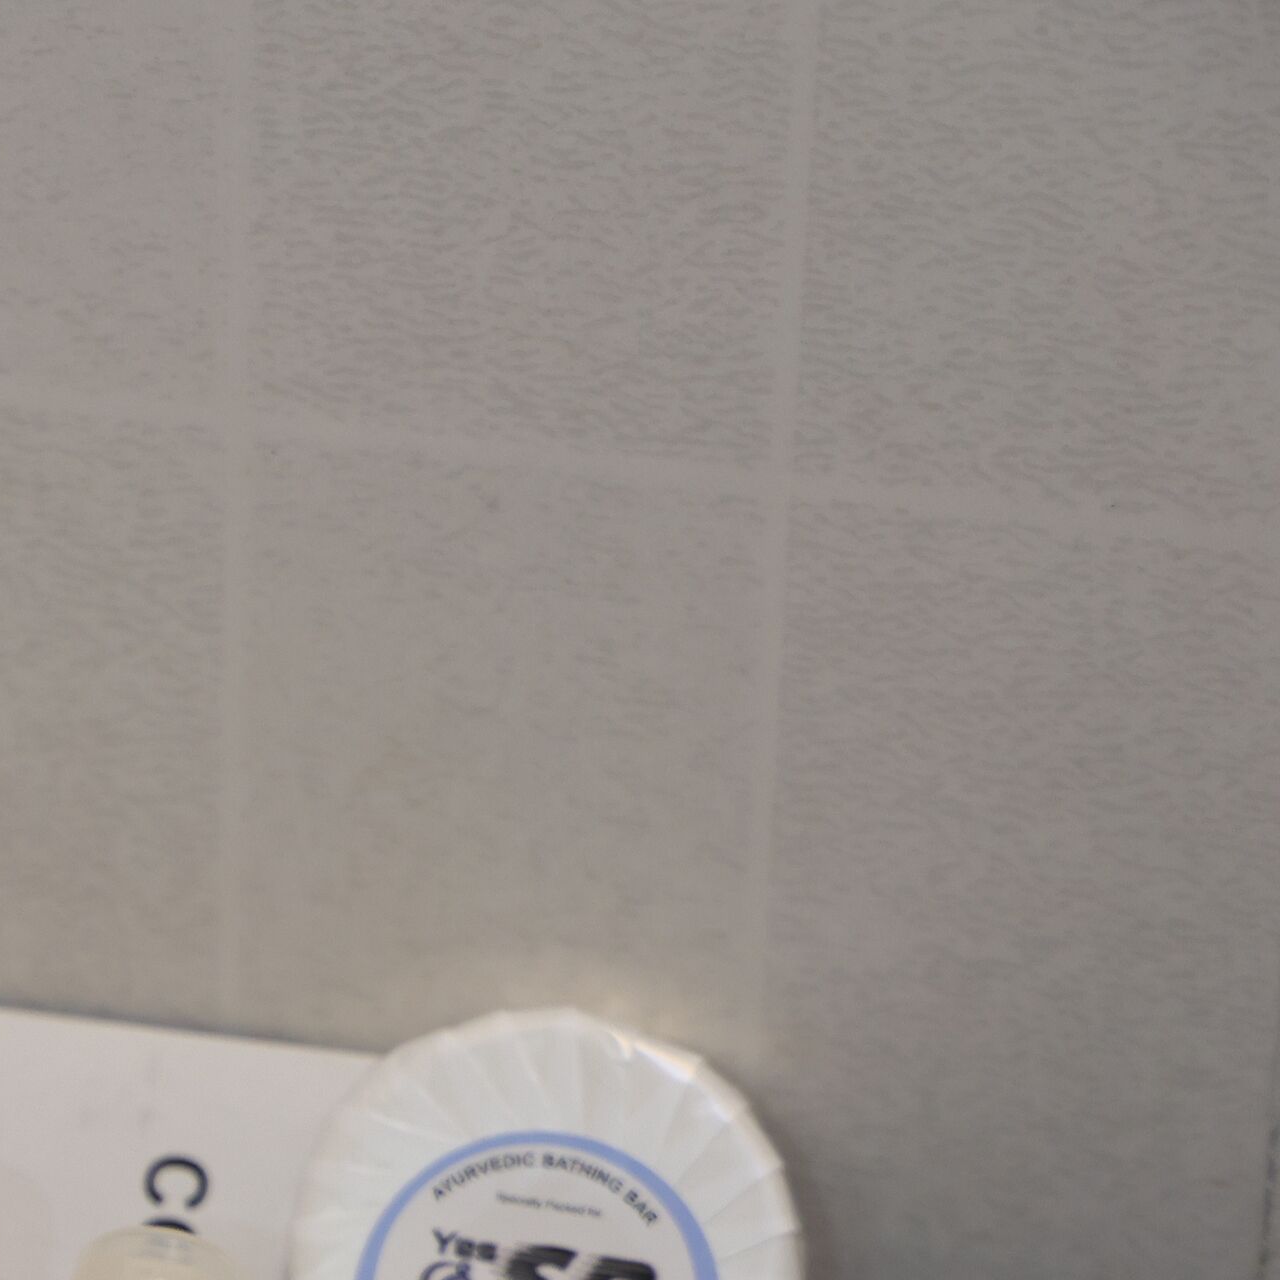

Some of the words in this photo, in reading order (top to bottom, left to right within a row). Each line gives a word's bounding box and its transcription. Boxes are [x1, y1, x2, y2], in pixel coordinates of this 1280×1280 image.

[432, 1151, 536, 1201] AYURVEDIC
[541, 1153, 624, 1194] BATHING
[622, 1188, 658, 1228] BAR
[432, 1228, 498, 1262] Yes
